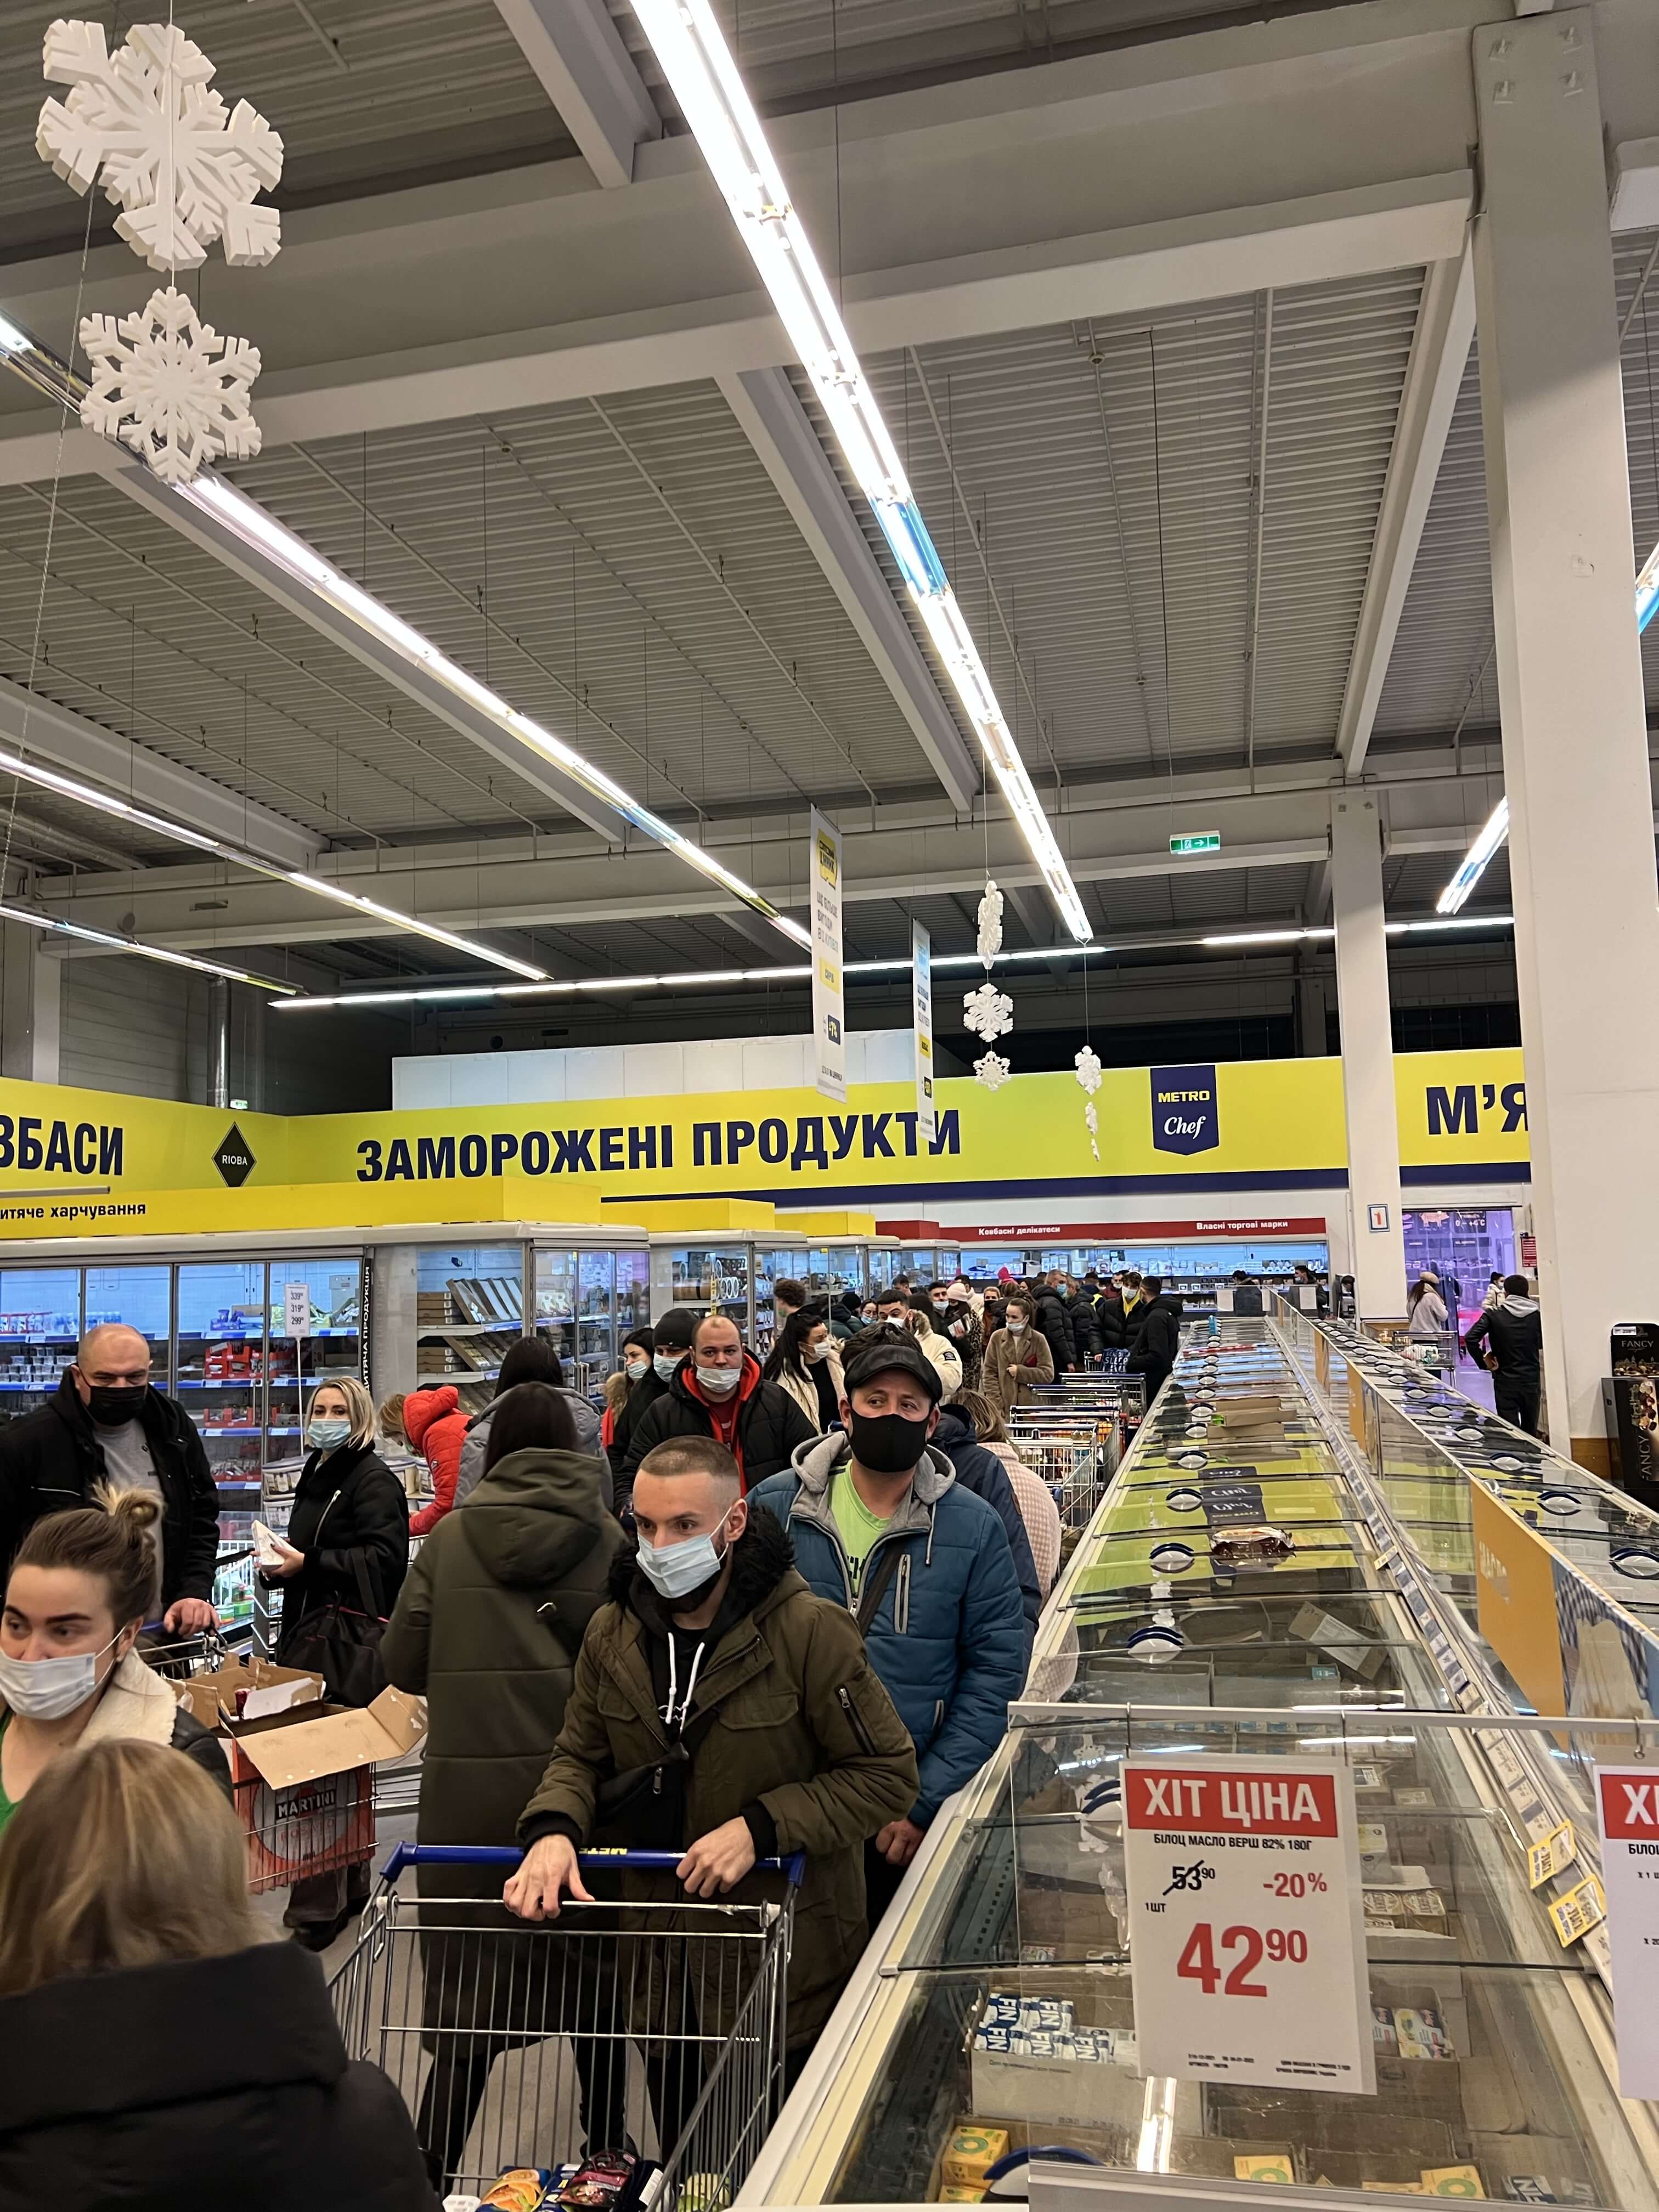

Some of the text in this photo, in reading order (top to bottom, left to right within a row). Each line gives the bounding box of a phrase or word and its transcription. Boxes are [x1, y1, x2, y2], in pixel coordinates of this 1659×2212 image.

[1158, 1091, 1210, 1103] METRO
[1164, 1115, 1206, 1139] Chef
[357, 1109, 961, 1182] ЗАМОРОЖЕНІ ПРОДУКТИ
[222, 1154, 247, 1166] RIOBA
[50, 1204, 146, 1221] харчування
[979, 1226, 1060, 1235] Ковбасні делікатеси
[1197, 1221, 1288, 1231] Власні торгові марки
[278, 1790, 335, 1818] MARTINI
[1143, 1777, 1322, 1828] ХІТ ЦІНА
[1154, 1833, 1312, 1850] БІЛОЦ МАСЛО ВЕРШ 82% 180Г
[998, 1997, 1017, 2021] FIN
[1040, 2001, 1060, 2027] FIN
[988, 2027, 1007, 2051] FIN
[1030, 2032, 1052, 2055] FIN
